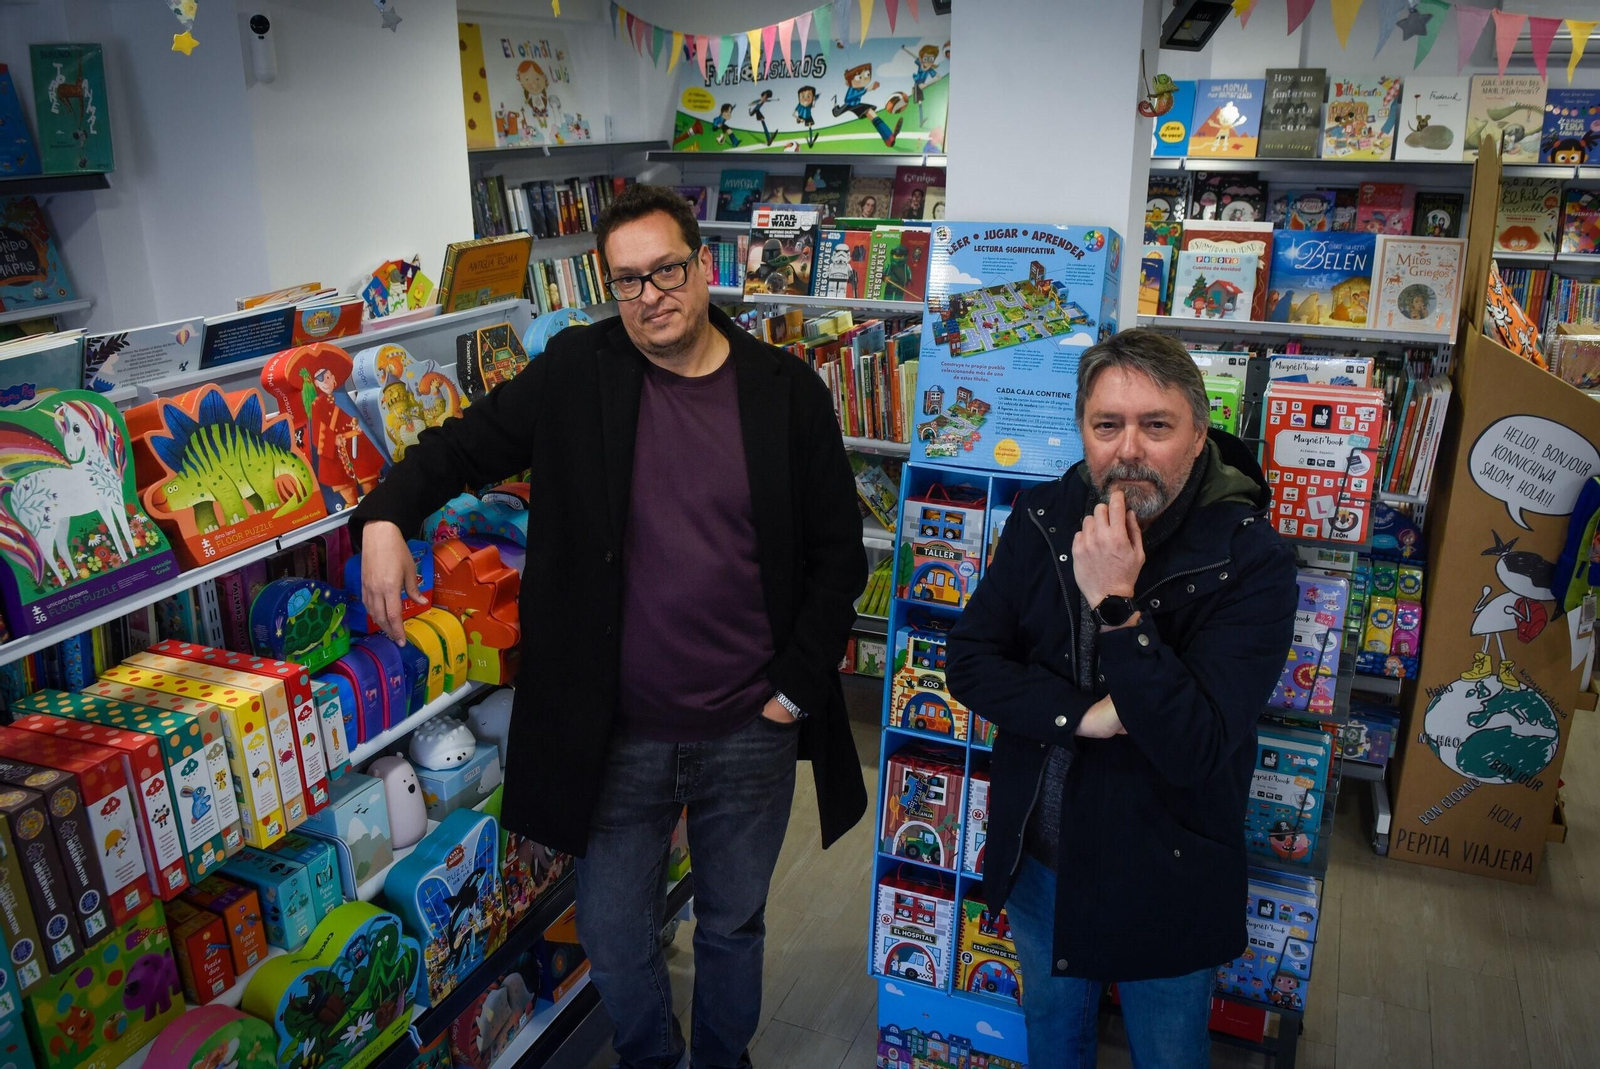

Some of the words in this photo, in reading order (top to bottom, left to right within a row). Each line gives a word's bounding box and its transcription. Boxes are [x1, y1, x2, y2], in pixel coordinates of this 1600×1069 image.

[500, 37, 515, 58] El
[518, 38, 552, 58] orinal
[1222, 83, 1248, 92] MOMIA
[1272, 88, 1317, 99] fantasma
[1428, 90, 1462, 101] Frederick
[946, 236, 970, 256] LEER
[984, 228, 1018, 241] JUGAR
[1032, 230, 1086, 260] APRENDER
[1006, 246, 1056, 255] SIGNIFICATIVA
[5, 252, 18, 262] EN
[498, 254, 518, 266] ROMA
[1196, 256, 1240, 264] POCOYO
[1294, 240, 1368, 272] BELÉN
[1396, 252, 1432, 266] Mitos
[821, 241, 832, 298] ERSONAJES
[1408, 264, 1450, 280] Griegos
[269, 358, 280, 371] and
[1036, 390, 1073, 399] CONTIENE:
[1491, 444, 1556, 484] KONNICHIWA
[1542, 444, 1592, 477] BONJOUR
[1516, 480, 1556, 508] HOLA!!!
[1316, 501, 1327, 514] L
[216, 534, 244, 548] FLOOR
[245, 521, 274, 537] PUZZLE
[203, 547, 216, 558] 36
[924, 548, 955, 560] TALLER
[46, 598, 67, 609] unicorn
[68, 589, 89, 601] dreams
[50, 600, 83, 617] FLOOR
[84, 584, 119, 604] PUZZLE
[34, 614, 48, 624] 36
[923, 680, 939, 688] ZOO
[1519, 668, 1568, 720] konnichiwa
[1436, 734, 1462, 749] HAO
[1489, 759, 1544, 792] BONJOUR
[1418, 804, 1443, 825] BON
[1441, 778, 1482, 808] GIORNO
[1487, 804, 1523, 832] HOLA
[72, 833, 87, 862] PUZZLE
[1396, 828, 1449, 858] PEPITA
[1463, 840, 1533, 874] VIAJERA
[39, 855, 55, 884] PUZZLE
[66, 840, 88, 887] OBSERVATION
[447, 859, 473, 882] PUZZLE
[33, 864, 57, 911] OBSERVATION
[240, 931, 256, 943] Puzzle
[902, 930, 934, 942] HOSPITAL
[973, 944, 999, 955] ESTACIÓN
[1007, 952, 1018, 960] TRE
[204, 958, 221, 972] Puzzle
[208, 966, 220, 976] duo
